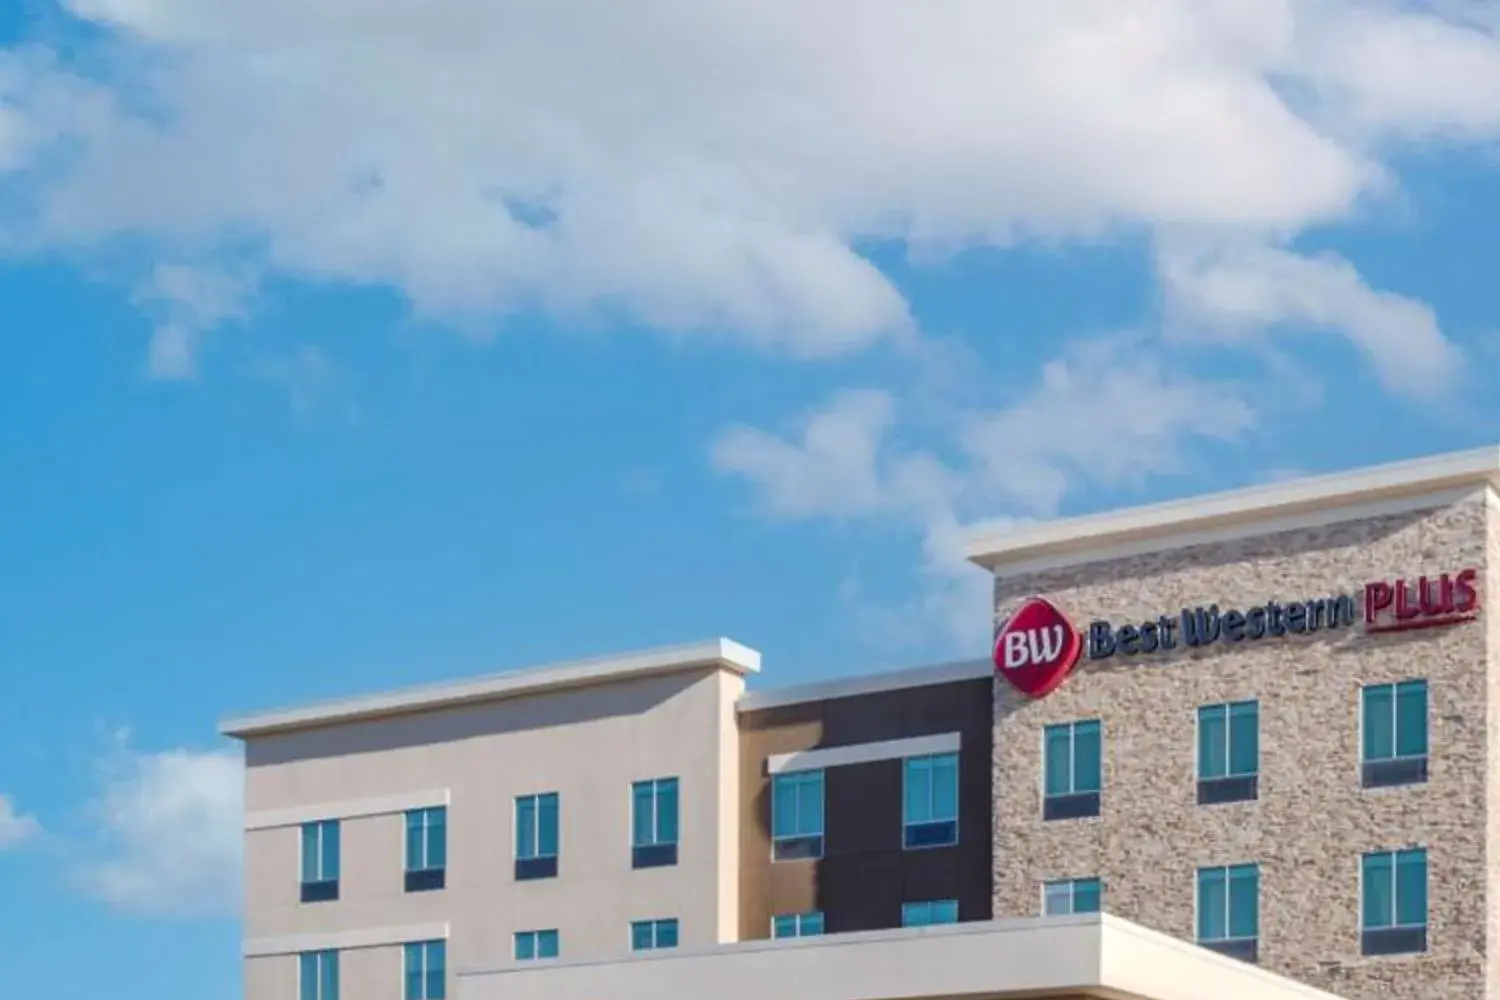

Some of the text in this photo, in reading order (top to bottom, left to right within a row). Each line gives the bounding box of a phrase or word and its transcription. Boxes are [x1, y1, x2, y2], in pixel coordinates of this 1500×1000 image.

[1004, 623, 1063, 668] BW
[1087, 568, 1477, 660] Best Western PLUS
